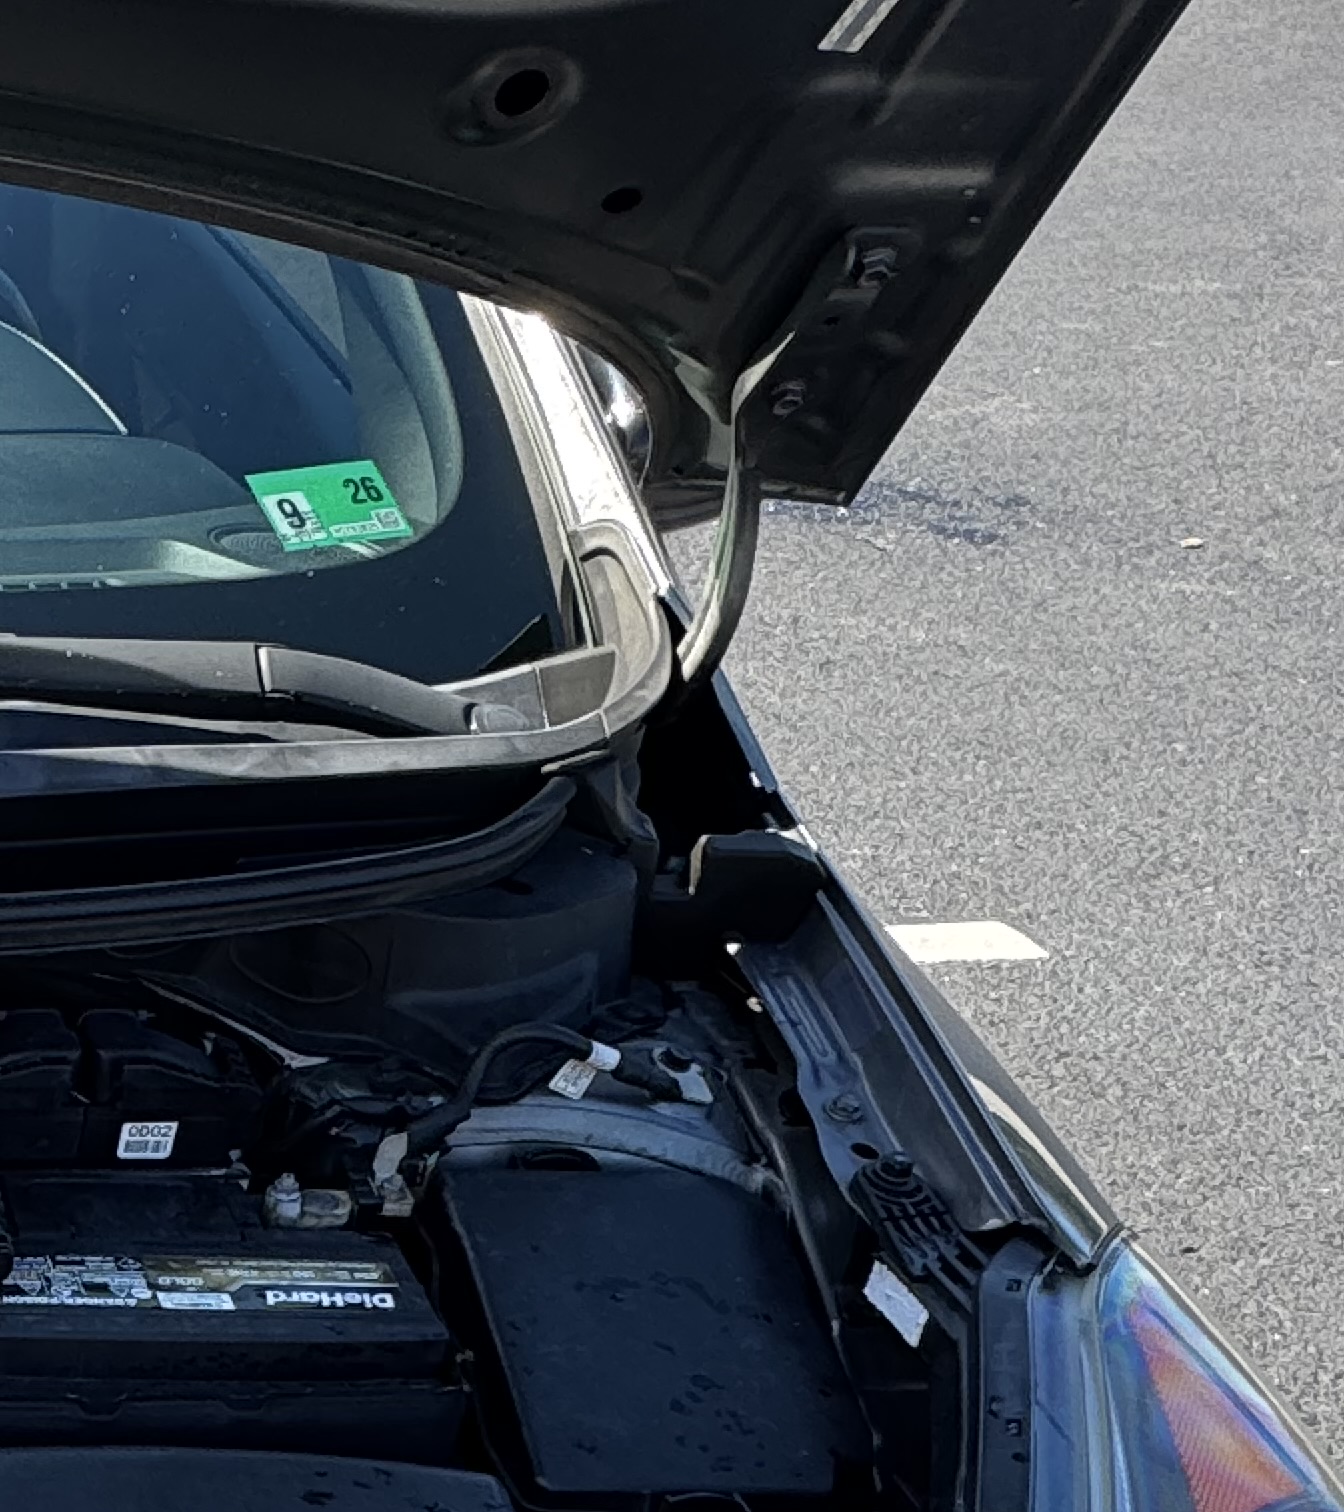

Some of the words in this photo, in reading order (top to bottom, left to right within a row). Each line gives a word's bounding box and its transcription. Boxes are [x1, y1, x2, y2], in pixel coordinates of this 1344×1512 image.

[342, 476, 384, 504] 26
[276, 498, 306, 529] 9
[264, 1290, 396, 1309] DieHard
